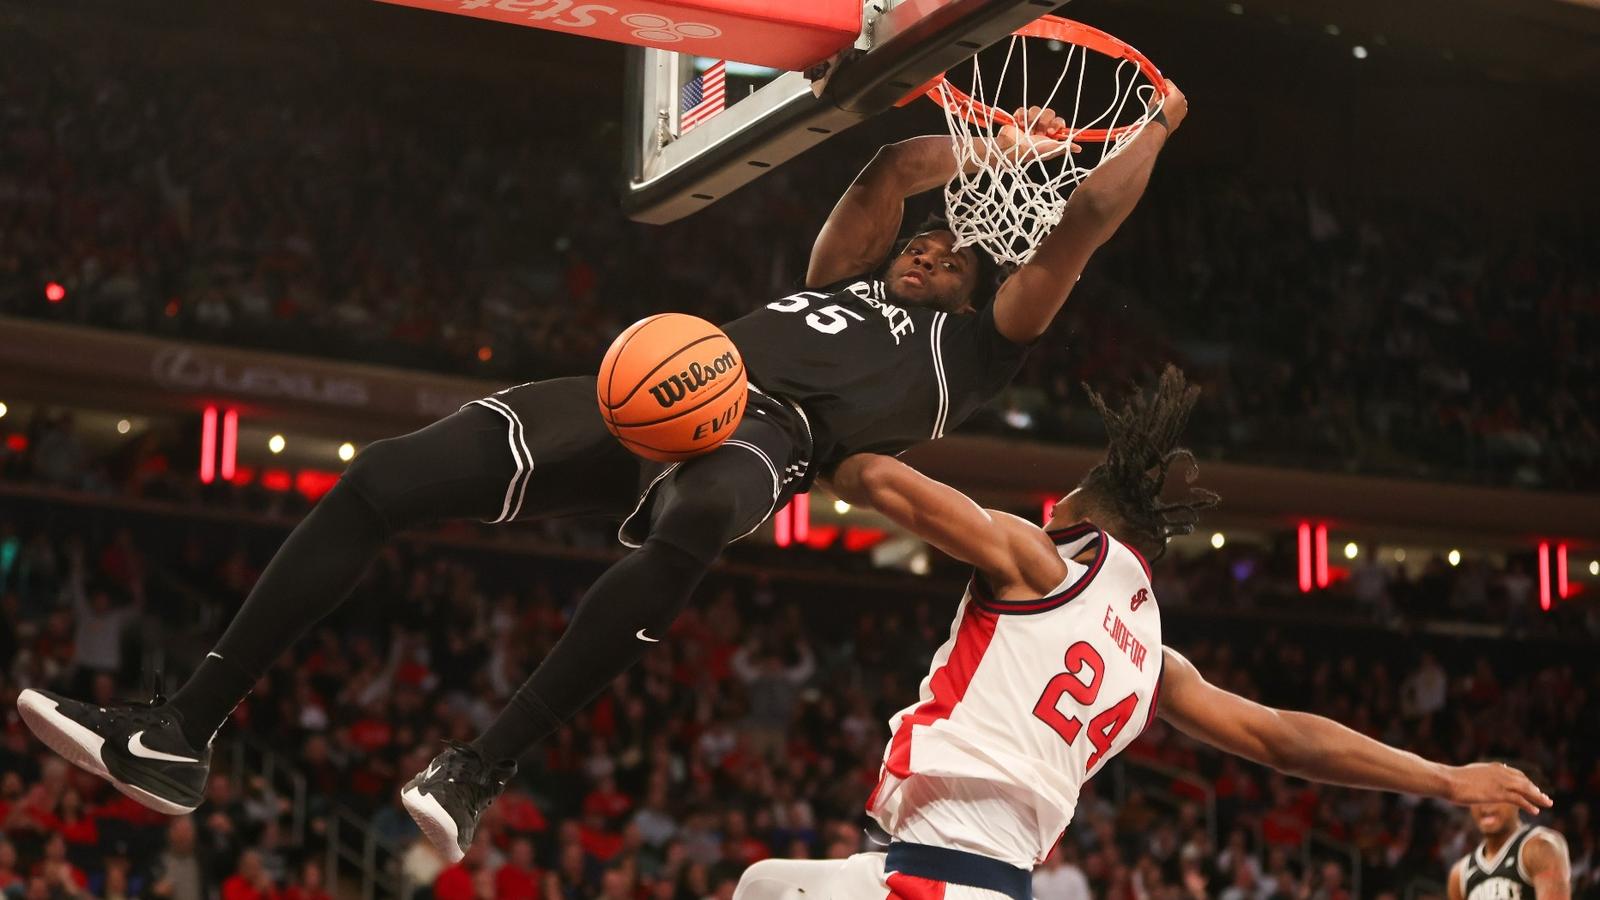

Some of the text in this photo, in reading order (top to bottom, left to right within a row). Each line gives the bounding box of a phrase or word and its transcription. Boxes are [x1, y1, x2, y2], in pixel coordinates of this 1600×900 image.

[766, 291, 866, 335] 55
[648, 351, 738, 408] Wilson
[1103, 604, 1148, 673] EJIOFOR
[1032, 640, 1139, 775] 24
